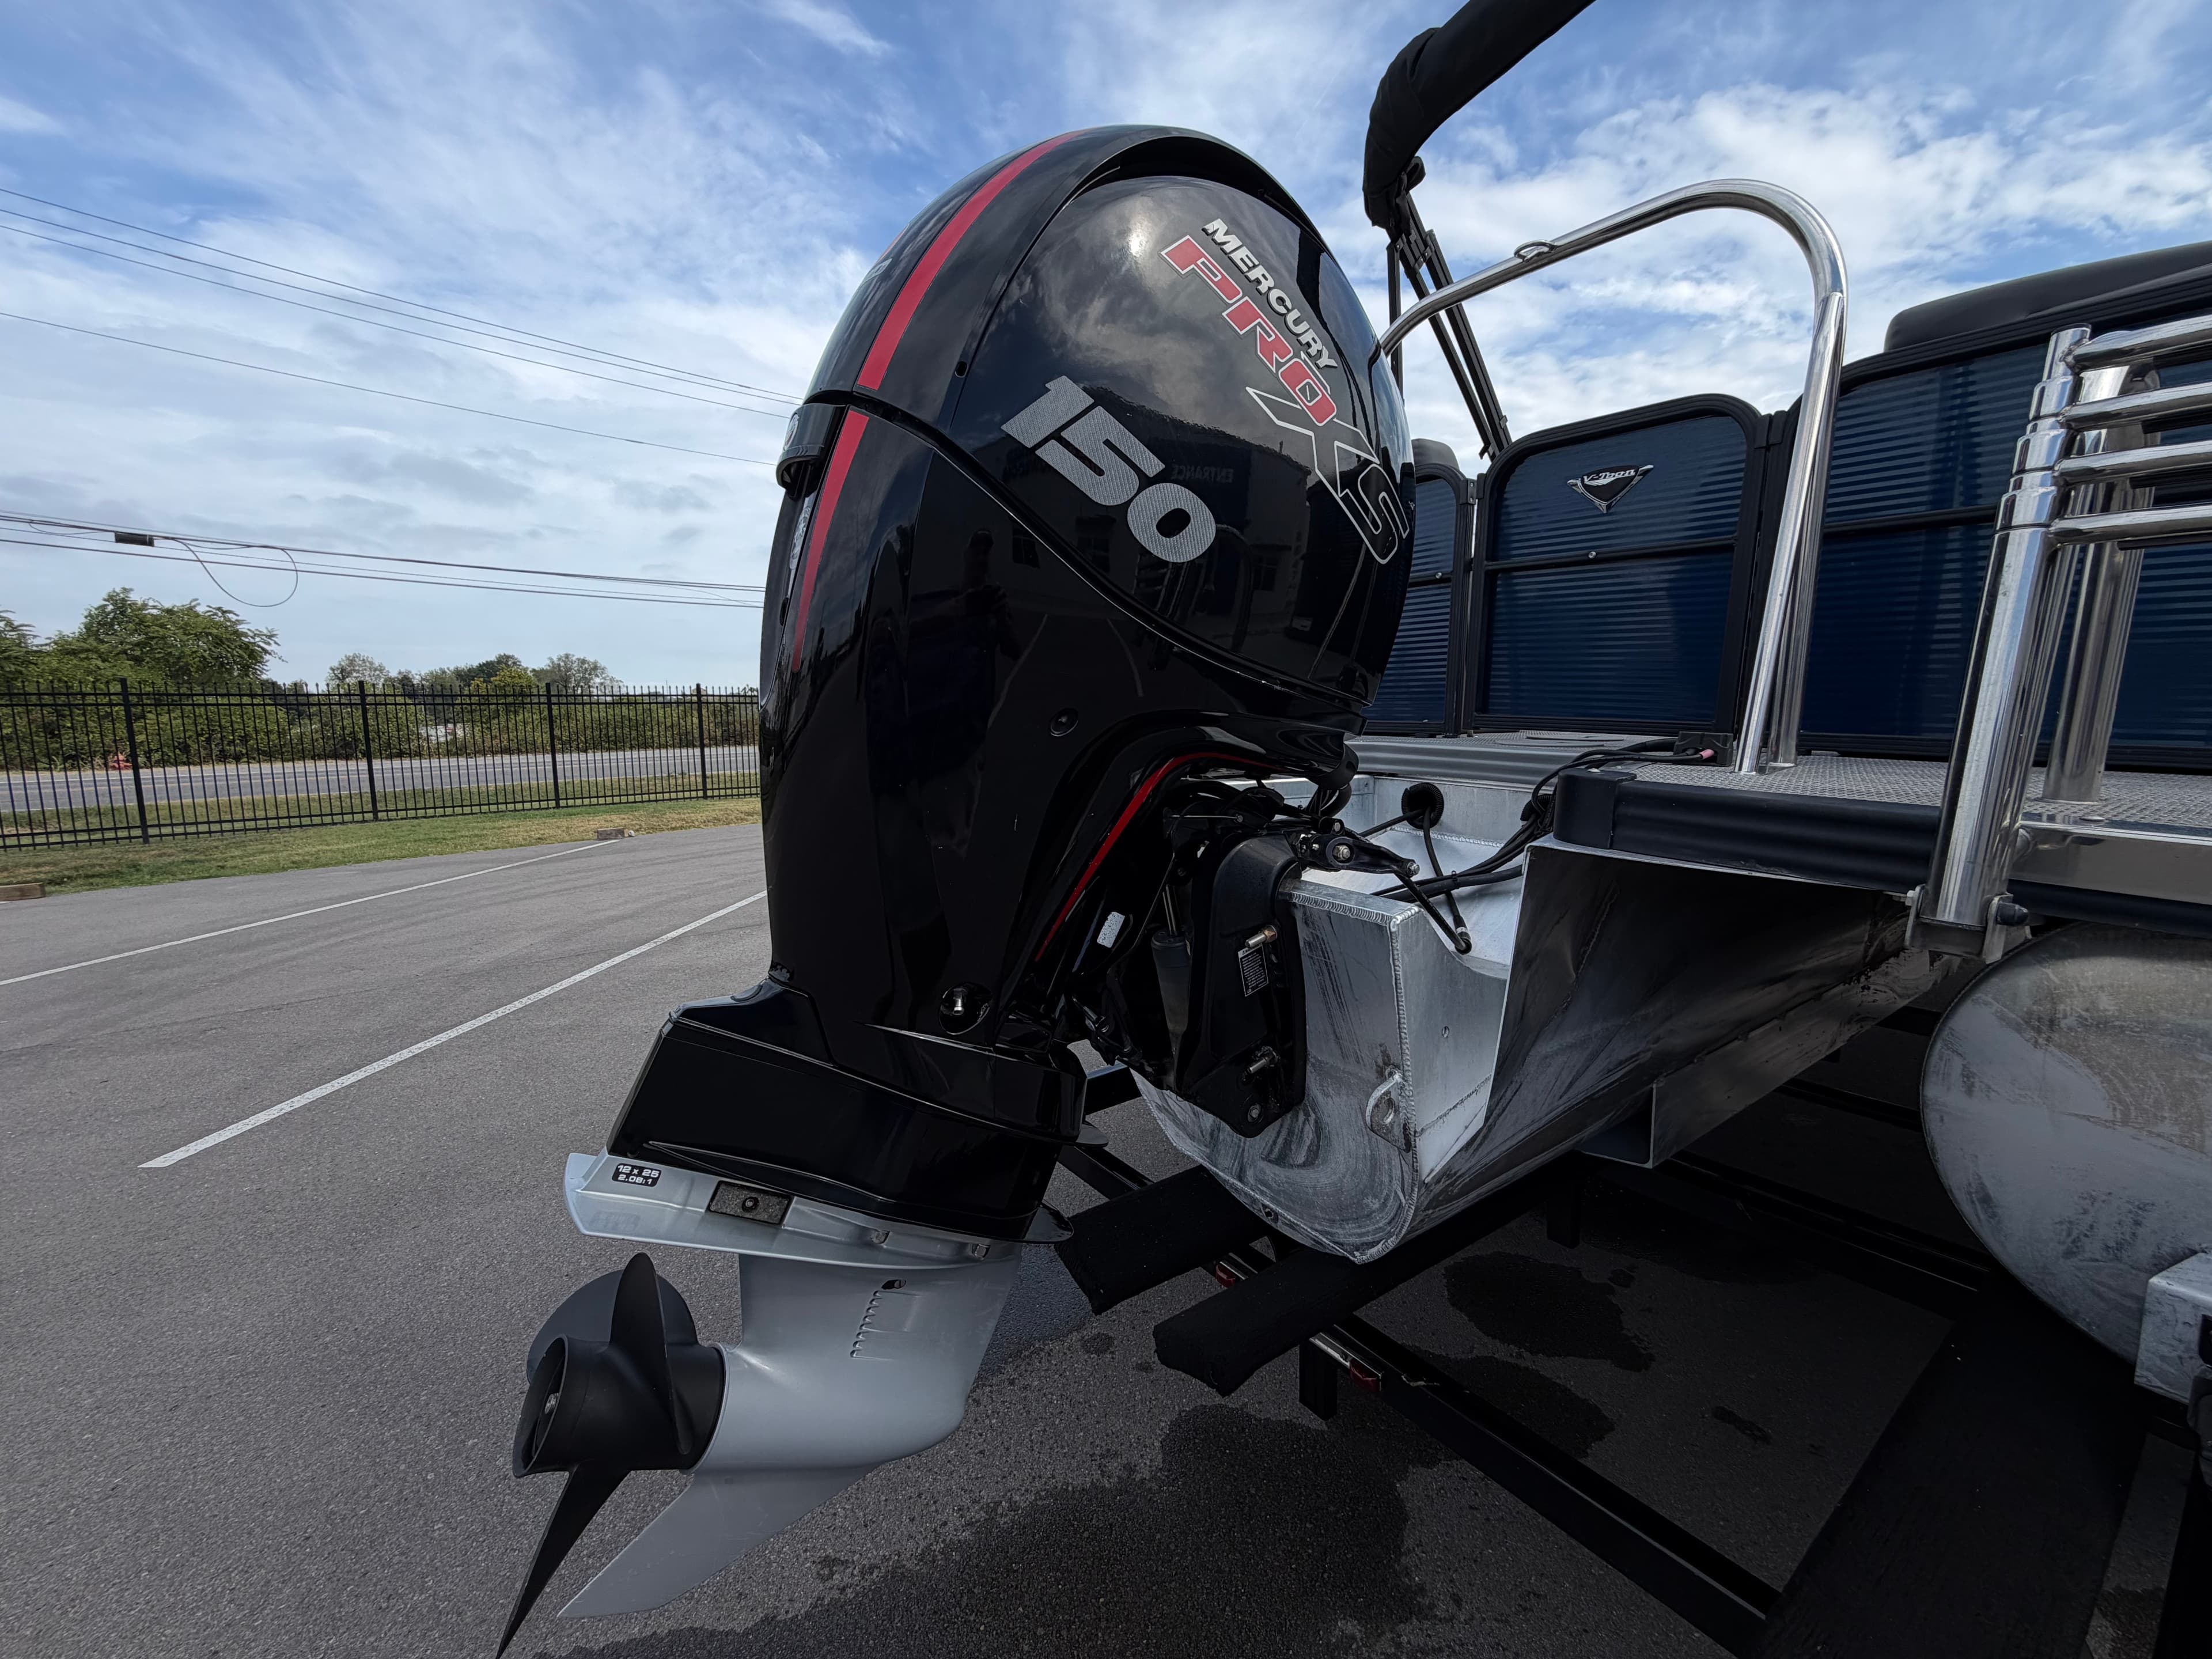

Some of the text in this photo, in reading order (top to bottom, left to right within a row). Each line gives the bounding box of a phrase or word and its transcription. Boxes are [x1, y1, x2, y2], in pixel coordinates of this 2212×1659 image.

[1202, 218, 1337, 369] MERCURY
[1160, 235, 1409, 563] PRO XS
[1001, 375, 1216, 563] 150
[1584, 469, 1636, 482] V-Toon
[618, 1165, 632, 1173] 12
[618, 1174, 652, 1184] 2.08:1
